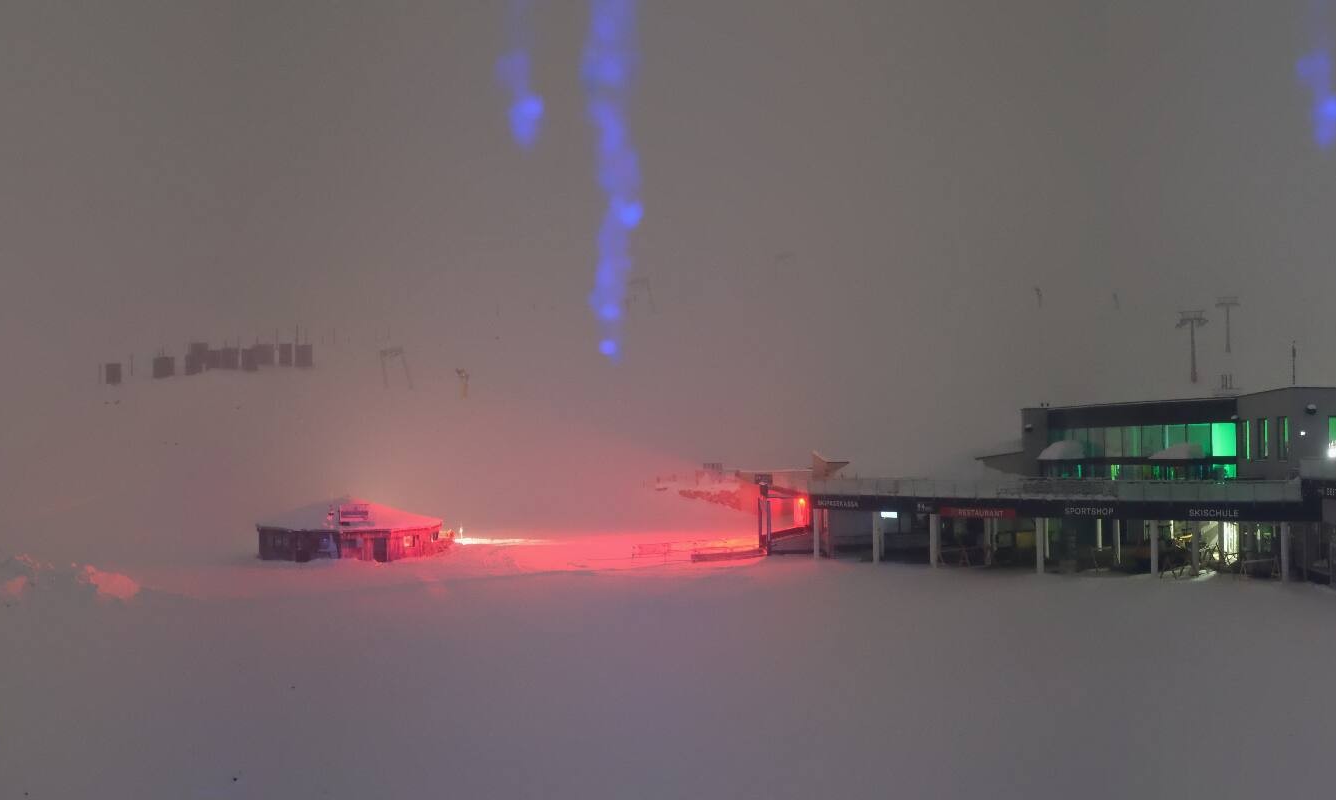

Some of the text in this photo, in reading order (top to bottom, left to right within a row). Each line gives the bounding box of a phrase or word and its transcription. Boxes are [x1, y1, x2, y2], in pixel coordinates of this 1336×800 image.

[958, 509, 1004, 517] RESTAURANT
[1064, 508, 1114, 516] SPORTSHOP
[1189, 509, 1240, 517] SKISCHULE
